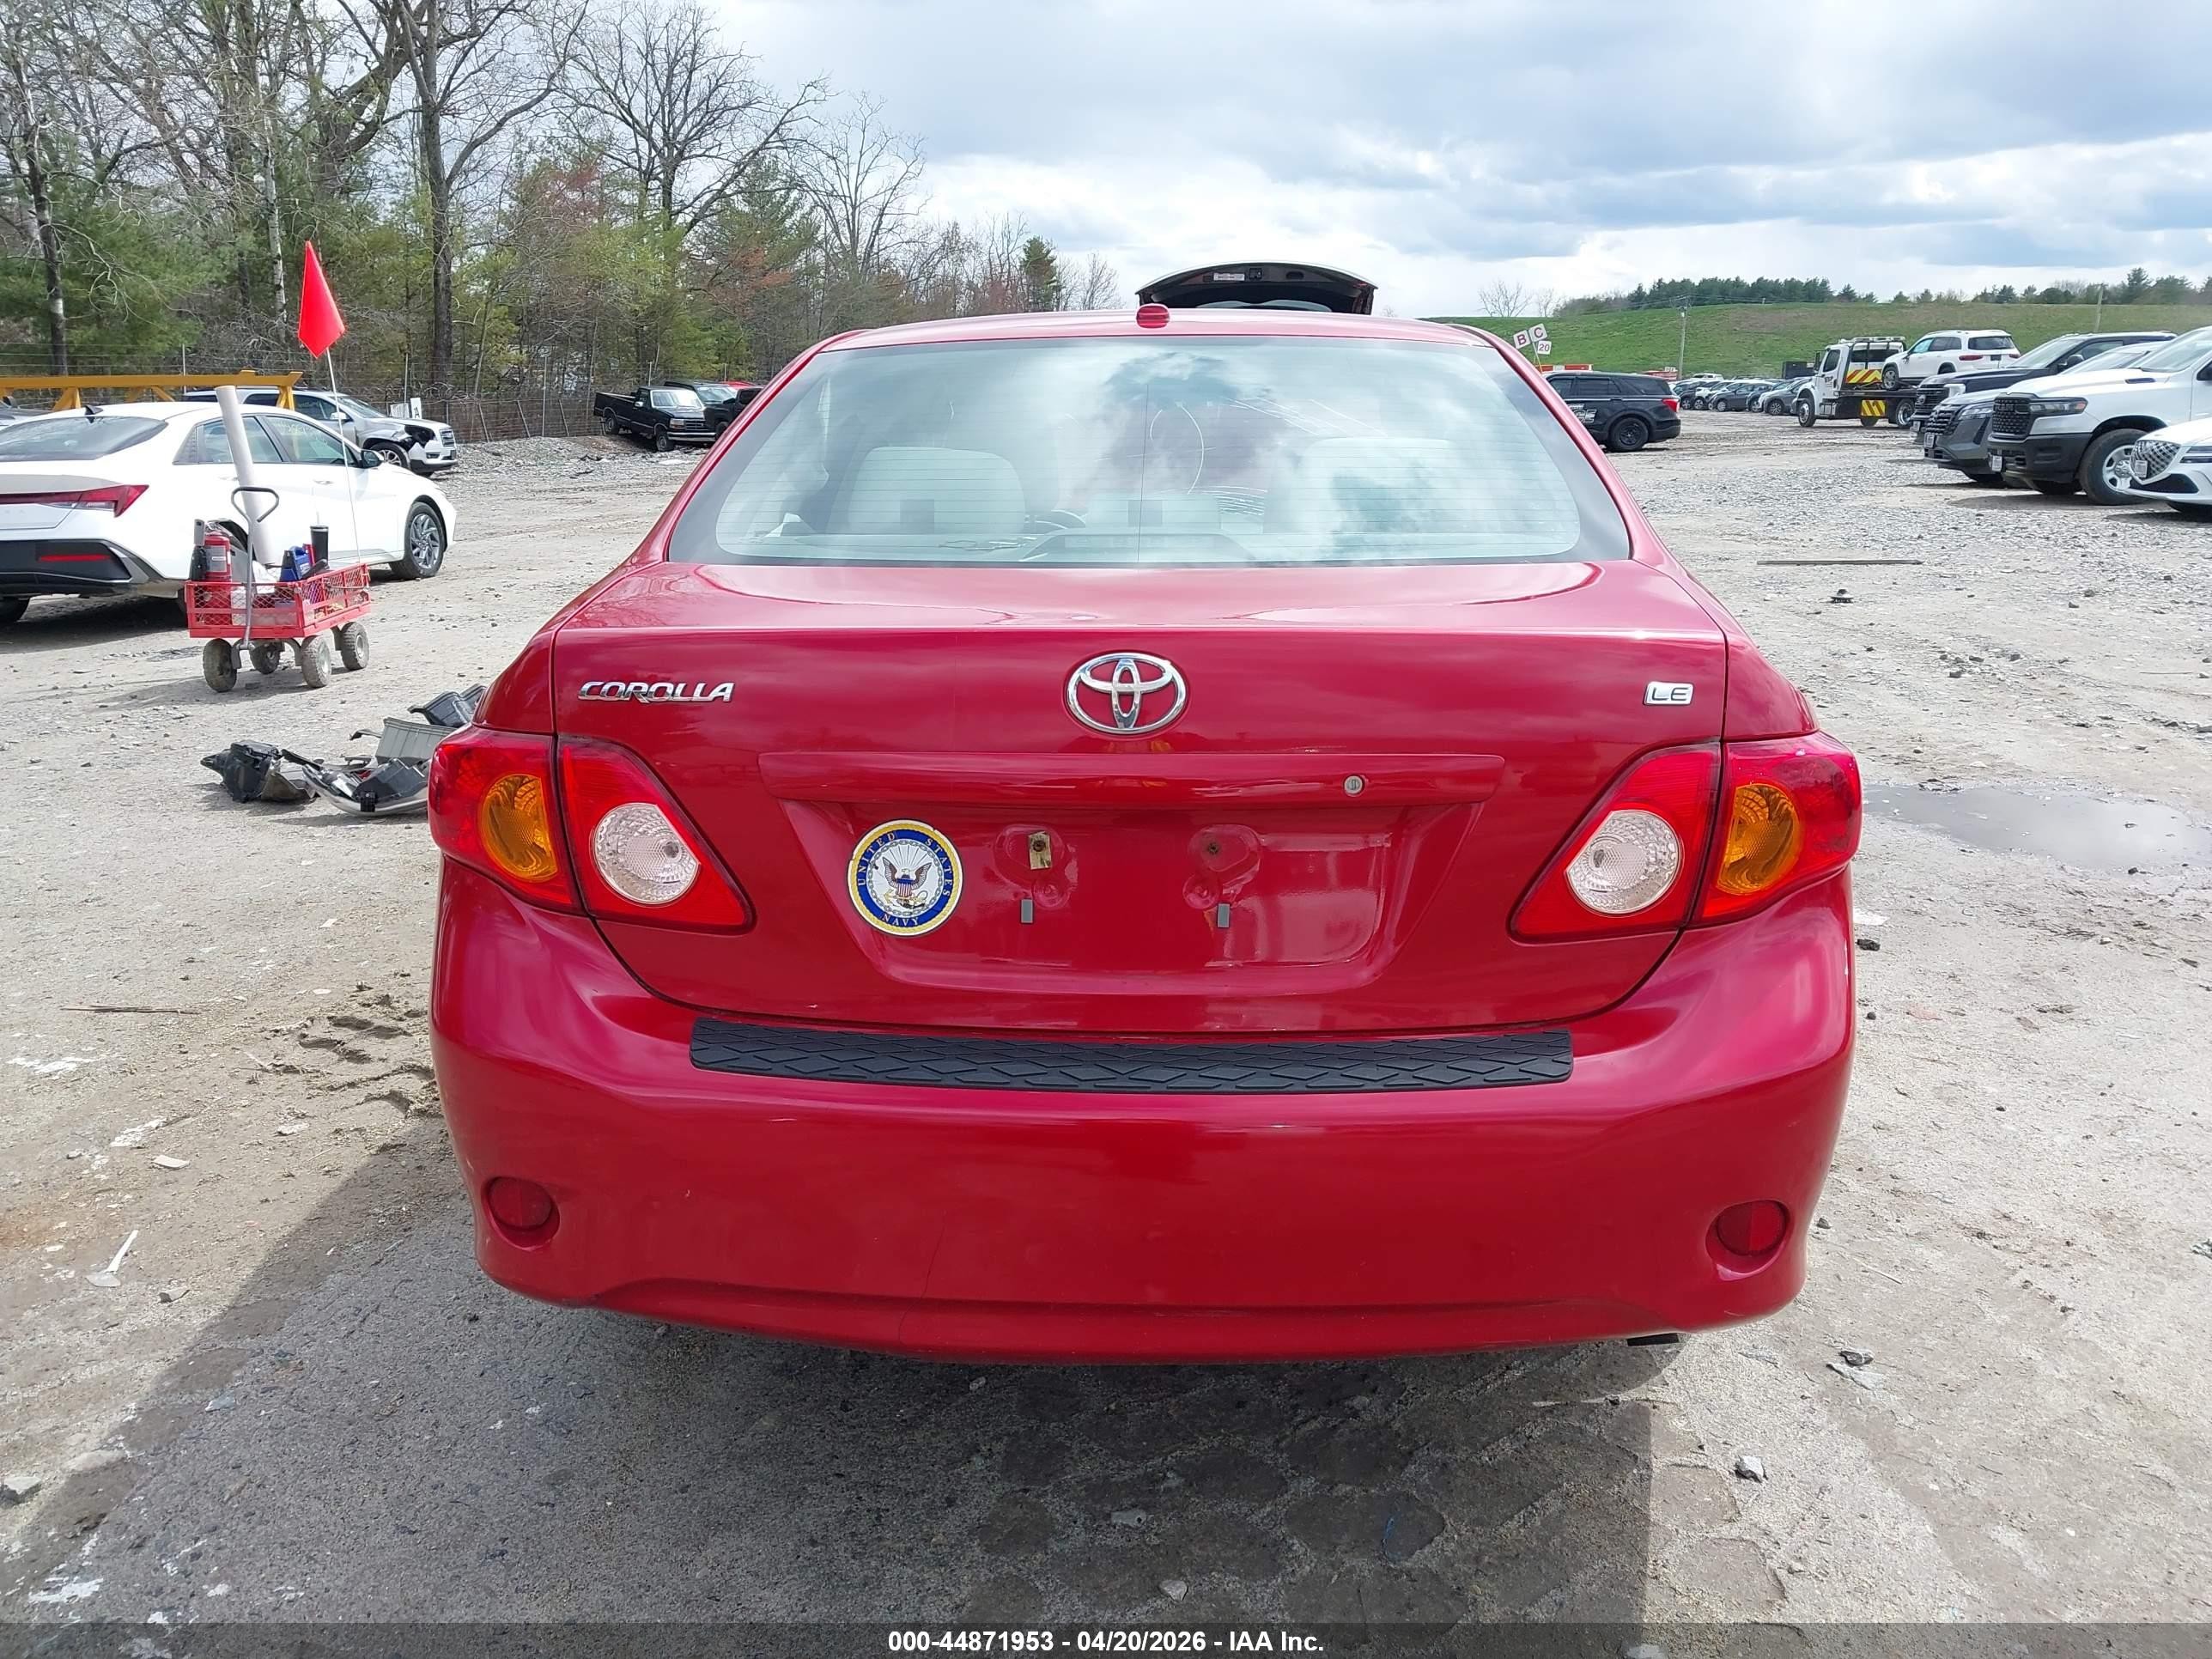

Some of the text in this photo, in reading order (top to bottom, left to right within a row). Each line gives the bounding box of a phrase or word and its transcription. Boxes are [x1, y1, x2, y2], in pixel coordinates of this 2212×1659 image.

[1516, 327, 1544, 345] B C
[1538, 343, 1550, 352] 20
[578, 681, 735, 703] COROLLA
[1651, 687, 1690, 702] LE
[858, 832, 953, 896] UNITED STATES
[882, 913, 920, 927] NAVY
